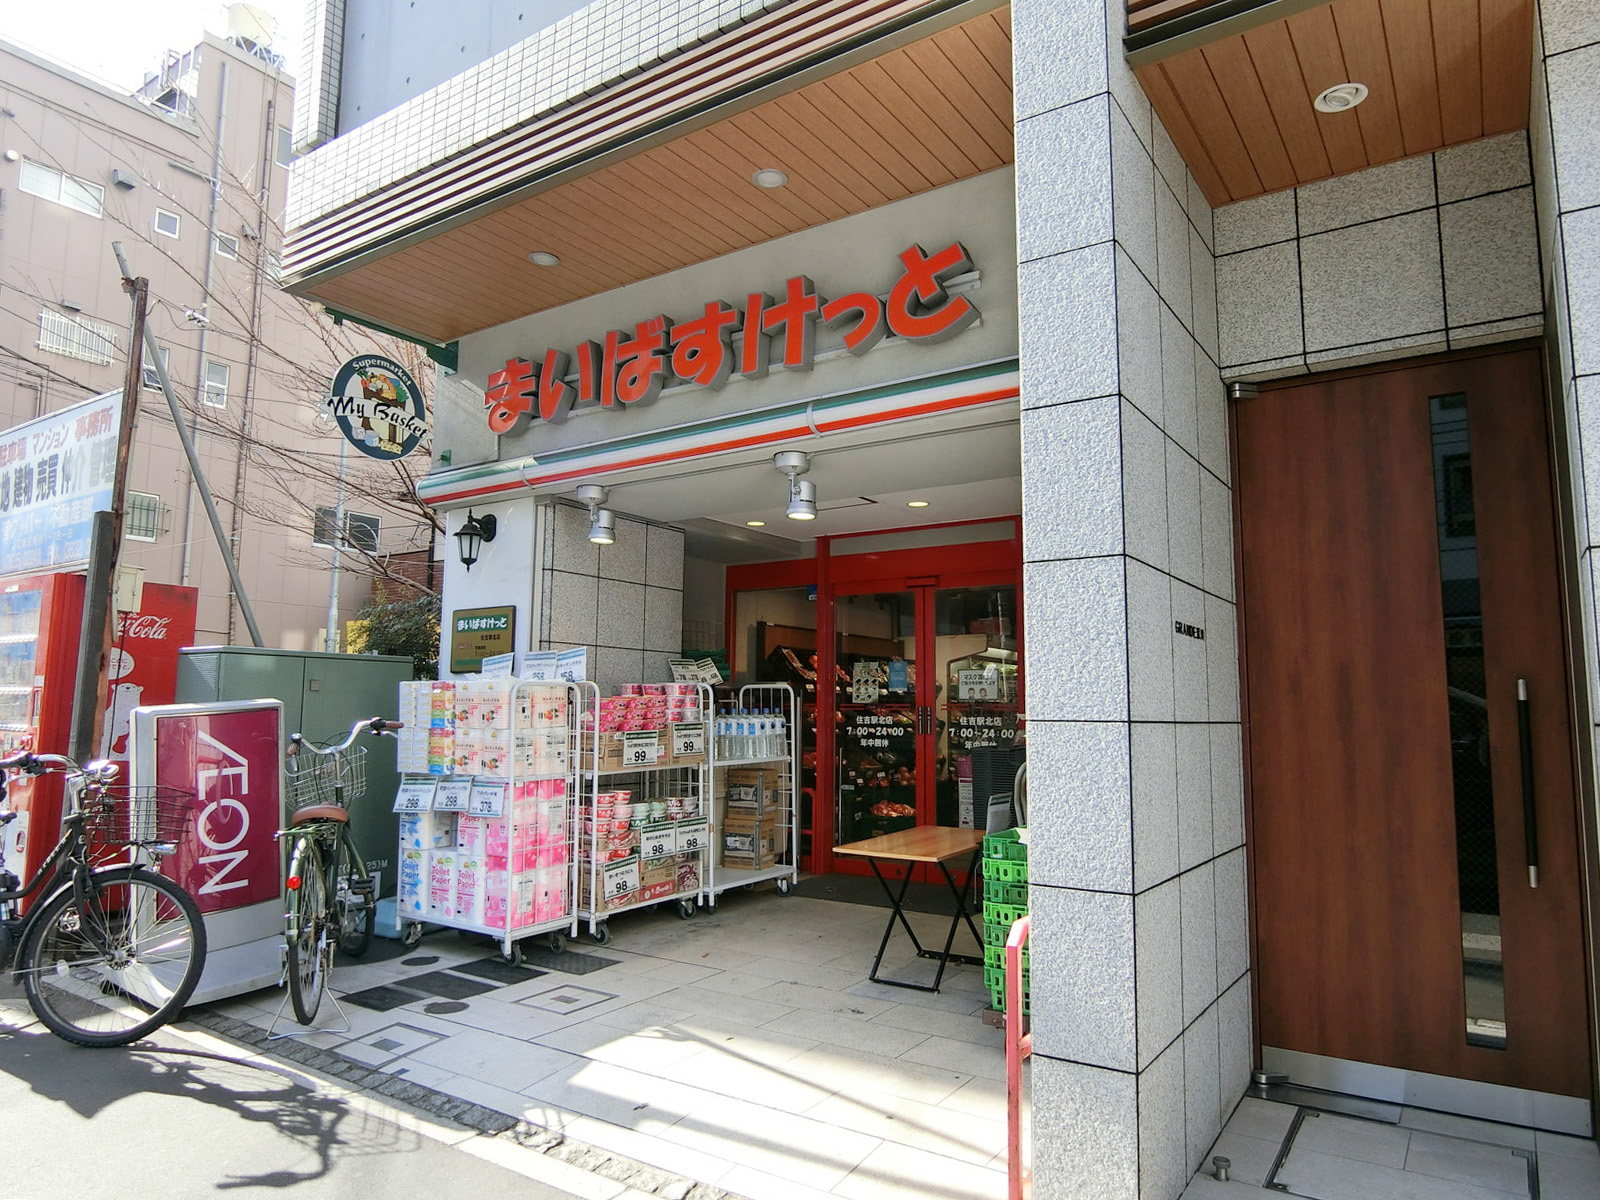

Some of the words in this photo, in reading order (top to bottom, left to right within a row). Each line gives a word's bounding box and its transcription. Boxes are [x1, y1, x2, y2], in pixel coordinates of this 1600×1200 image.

[484, 241, 979, 437] まいばすけっと
[352, 358, 412, 386] Supermarket
[327, 396, 365, 418] My
[373, 402, 428, 439] Basket
[33, 423, 69, 455] マンション
[75, 405, 114, 442] 事務所
[36, 453, 59, 502] 売買
[457, 616, 508, 631] まいばすけっと
[856, 716, 893, 725] 住吉駅北店
[959, 716, 1002, 726] 住吉駅北店
[683, 741, 694, 752] 99
[634, 751, 646, 762] 99
[405, 798, 419, 809] 298
[445, 796, 457, 807] 298
[480, 801, 492, 812] 378
[198, 730, 250, 895] AEON
[686, 838, 698, 849] 98
[652, 844, 664, 855] 98
[432, 866, 450, 876] Toilet
[458, 869, 475, 880] Toilet
[432, 875, 451, 885] Paper
[457, 879, 475, 890] Paper
[616, 880, 628, 893] 98
